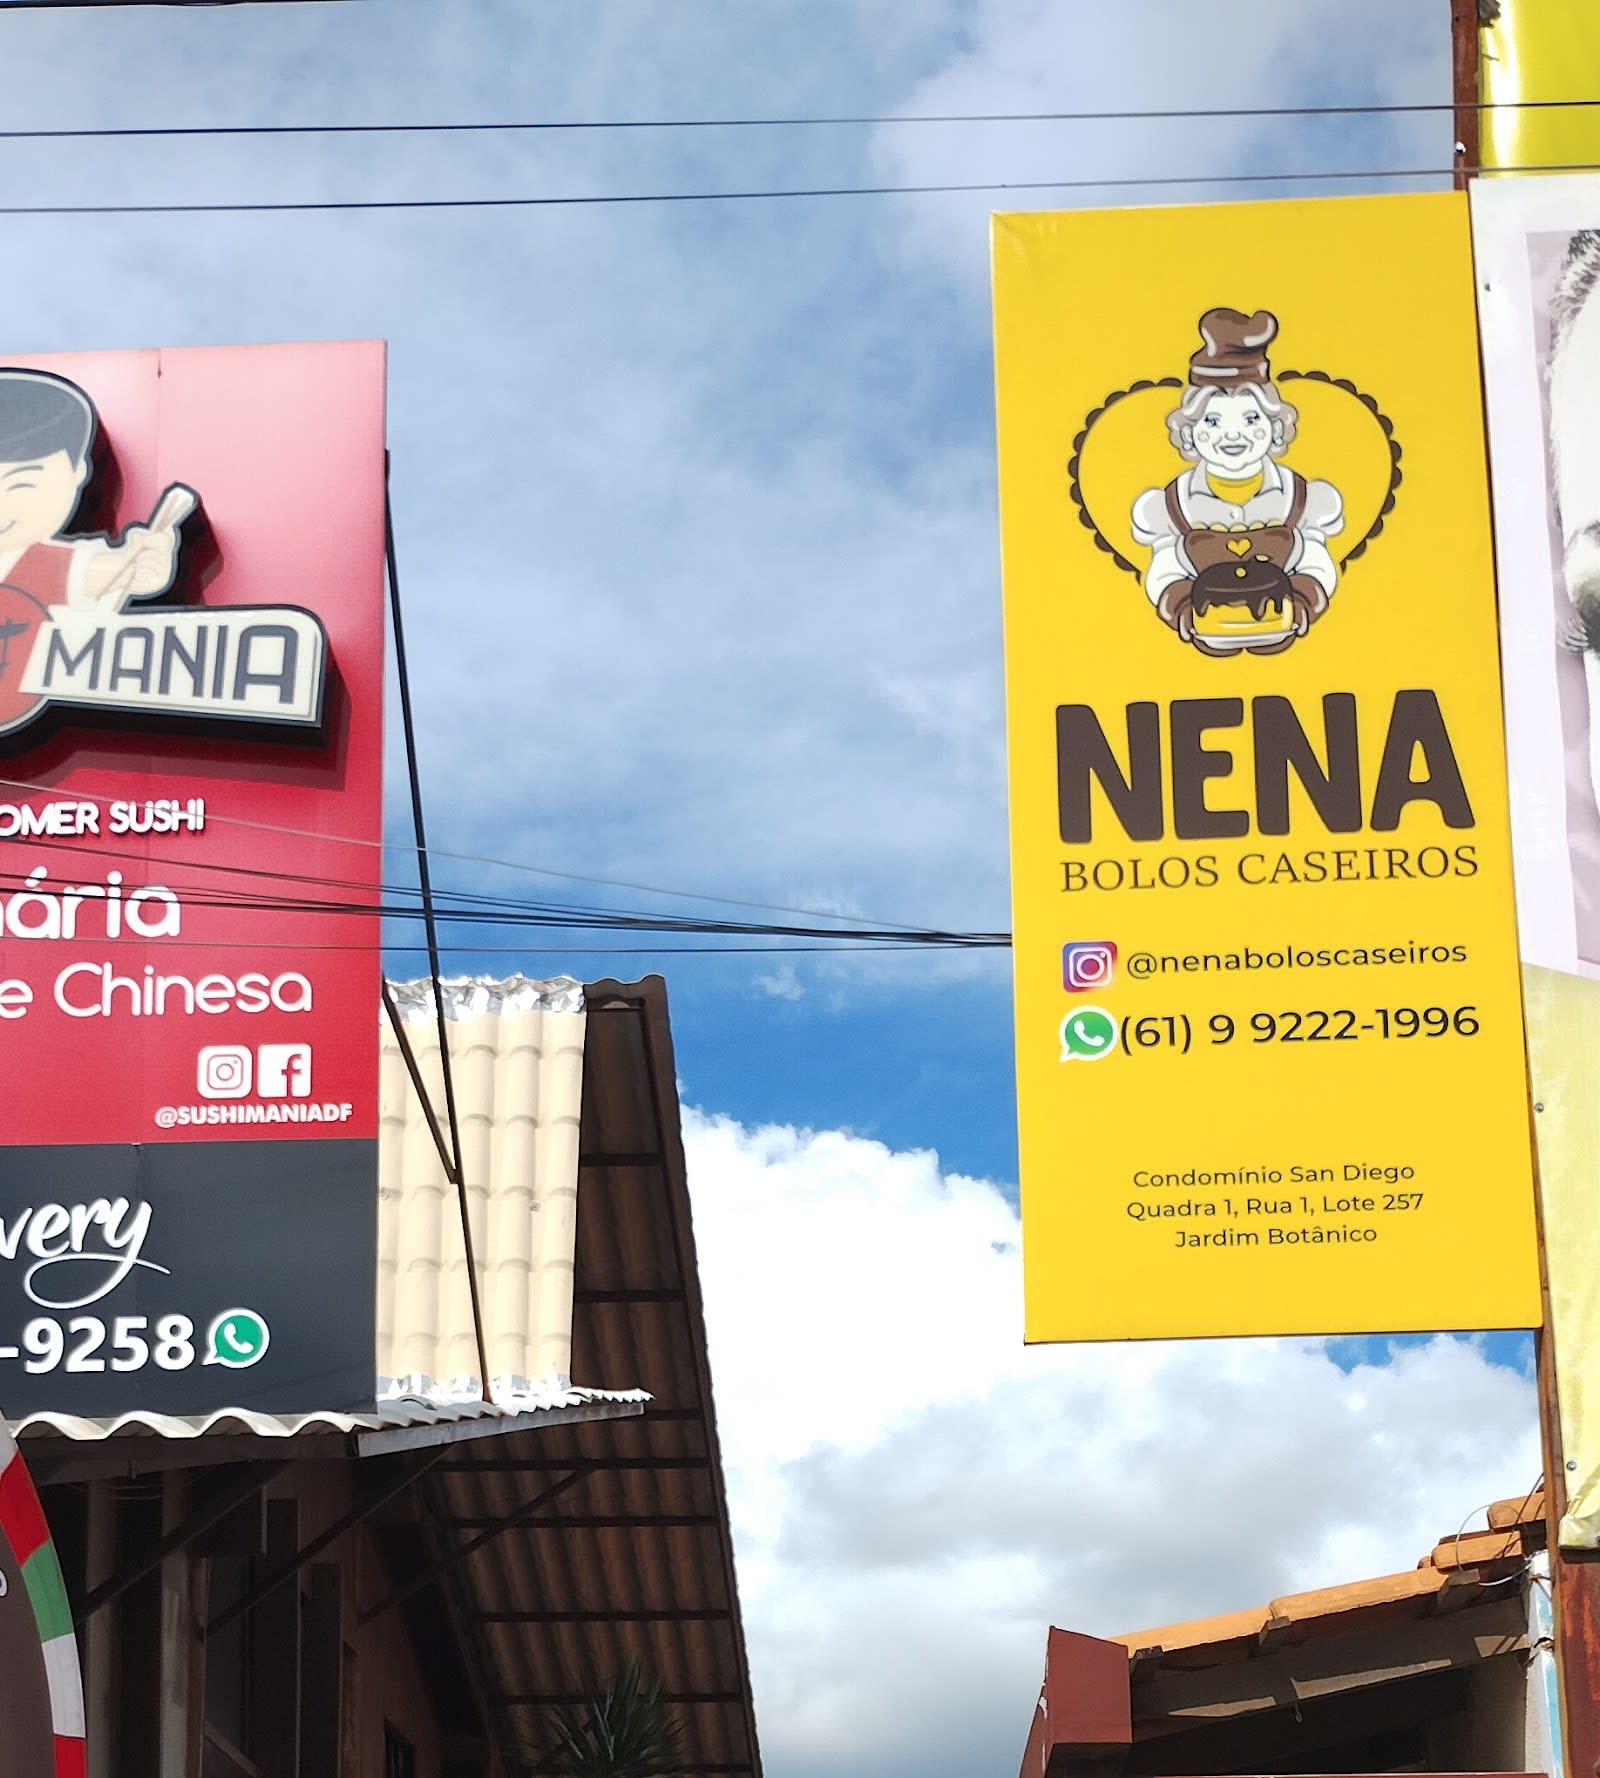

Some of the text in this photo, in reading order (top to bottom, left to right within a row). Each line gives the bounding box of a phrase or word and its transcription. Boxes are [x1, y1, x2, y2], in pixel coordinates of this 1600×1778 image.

[42, 622, 299, 705] MANIA
[1055, 689, 1476, 845] NENA
[109, 798, 206, 834] SUSHI
[1060, 845, 1480, 893] BOLOS CASEIROS
[0, 865, 181, 940] ária
[1126, 940, 1468, 980] @nenaboloscaseiros
[53, 961, 313, 1018] Chinesa
[1120, 1005, 1480, 1057] (61) 9 9222-1996
[154, 1102, 354, 1129] @SUSHIMANIADF
[1132, 1161, 1416, 1189] Condomínio San Diego
[1126, 1192, 1425, 1221] Quadra 1, Rua 1, Lote 257
[1174, 1223, 1378, 1249] Jardim Botânico
